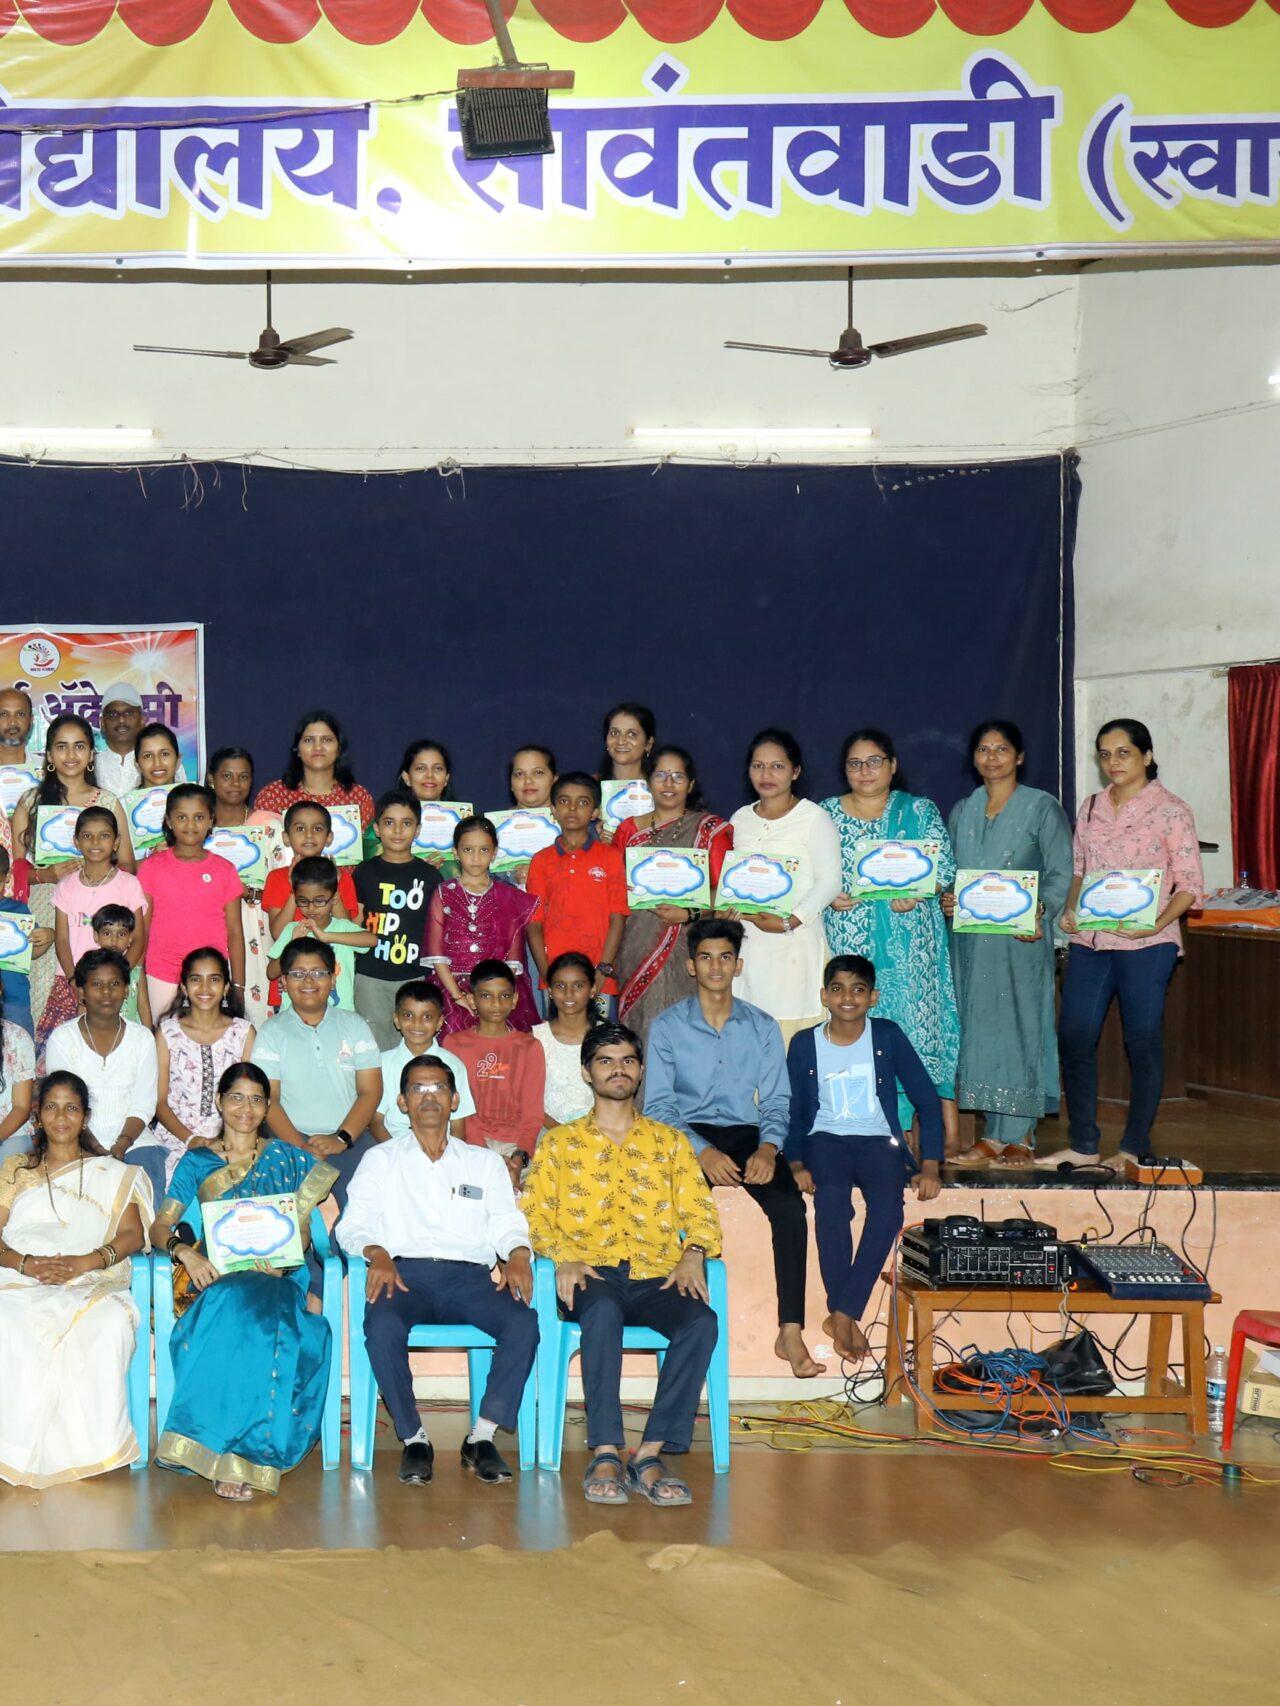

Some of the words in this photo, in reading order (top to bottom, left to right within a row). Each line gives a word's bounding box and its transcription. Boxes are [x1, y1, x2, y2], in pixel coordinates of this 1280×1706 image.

[1087, 103, 1280, 222] (स्वा
[379, 878, 424, 910] TOO
[366, 912, 400, 936] HIP
[375, 934, 419, 964] HOP
